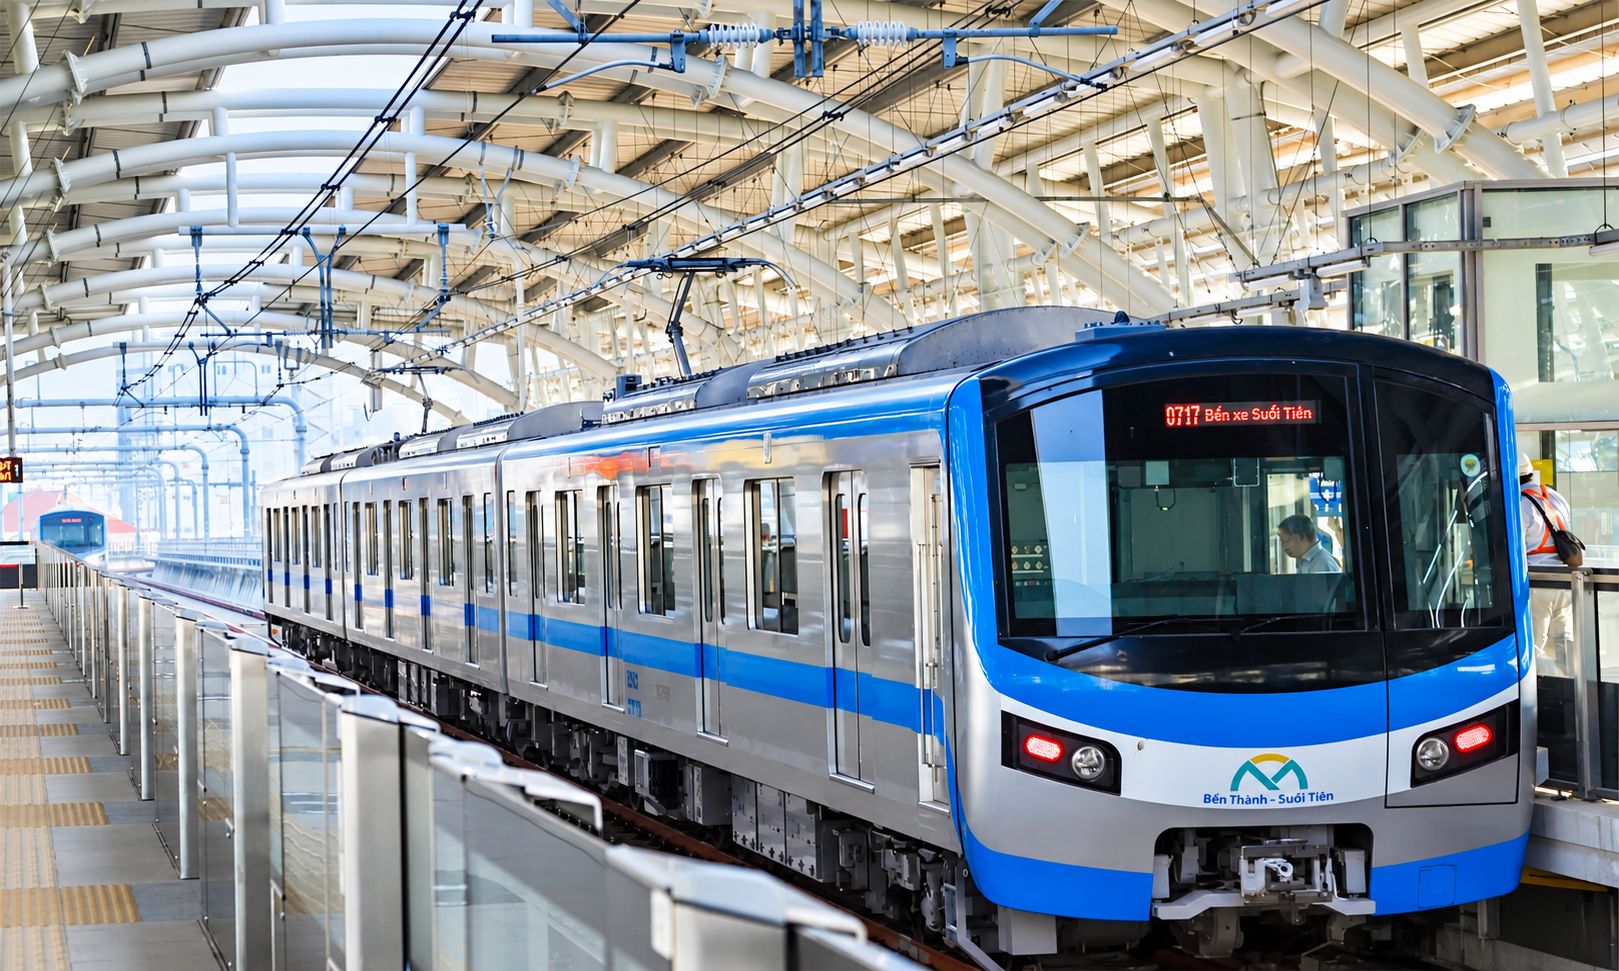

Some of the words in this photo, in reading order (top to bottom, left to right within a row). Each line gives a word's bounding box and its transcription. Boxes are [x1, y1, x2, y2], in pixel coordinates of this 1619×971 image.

[1166, 405, 1200, 426] 0717
[1204, 405, 1230, 422] Bến
[1233, 409, 1249, 421] xe
[1251, 404, 1280, 420] Suối
[1203, 793, 1227, 805] Bến
[1229, 794, 1268, 805] Thành
[1308, 791, 1334, 801] Tiên
